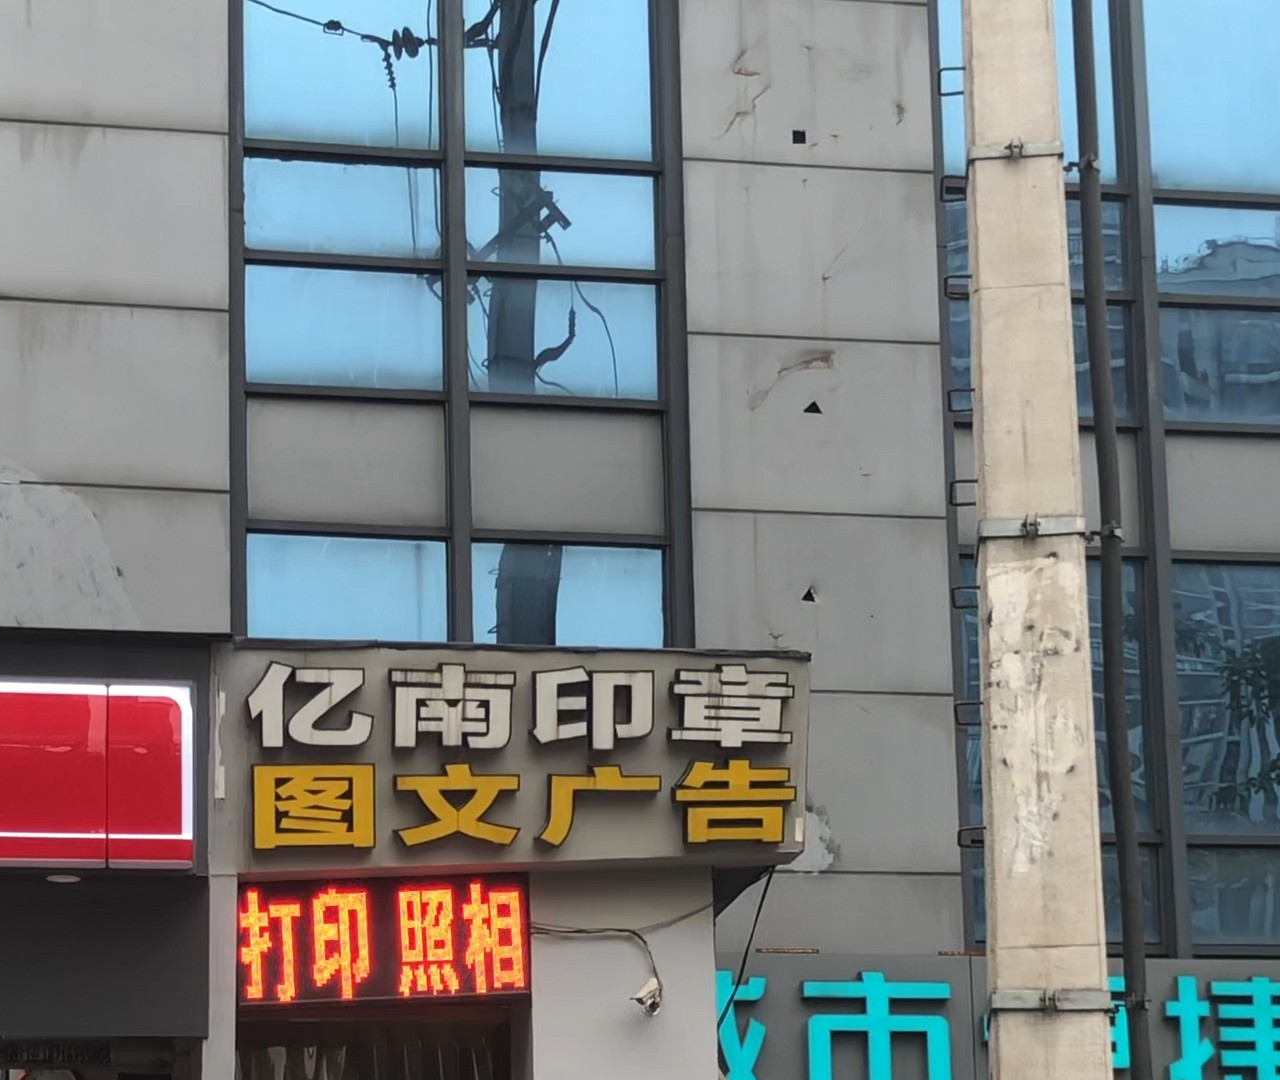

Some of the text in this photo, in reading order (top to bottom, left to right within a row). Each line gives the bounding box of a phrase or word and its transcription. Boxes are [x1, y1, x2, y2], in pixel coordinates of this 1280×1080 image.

[247, 661, 794, 750] 亿南印章
[251, 759, 796, 849] 图文广告
[239, 882, 526, 1001] 打印 照相
